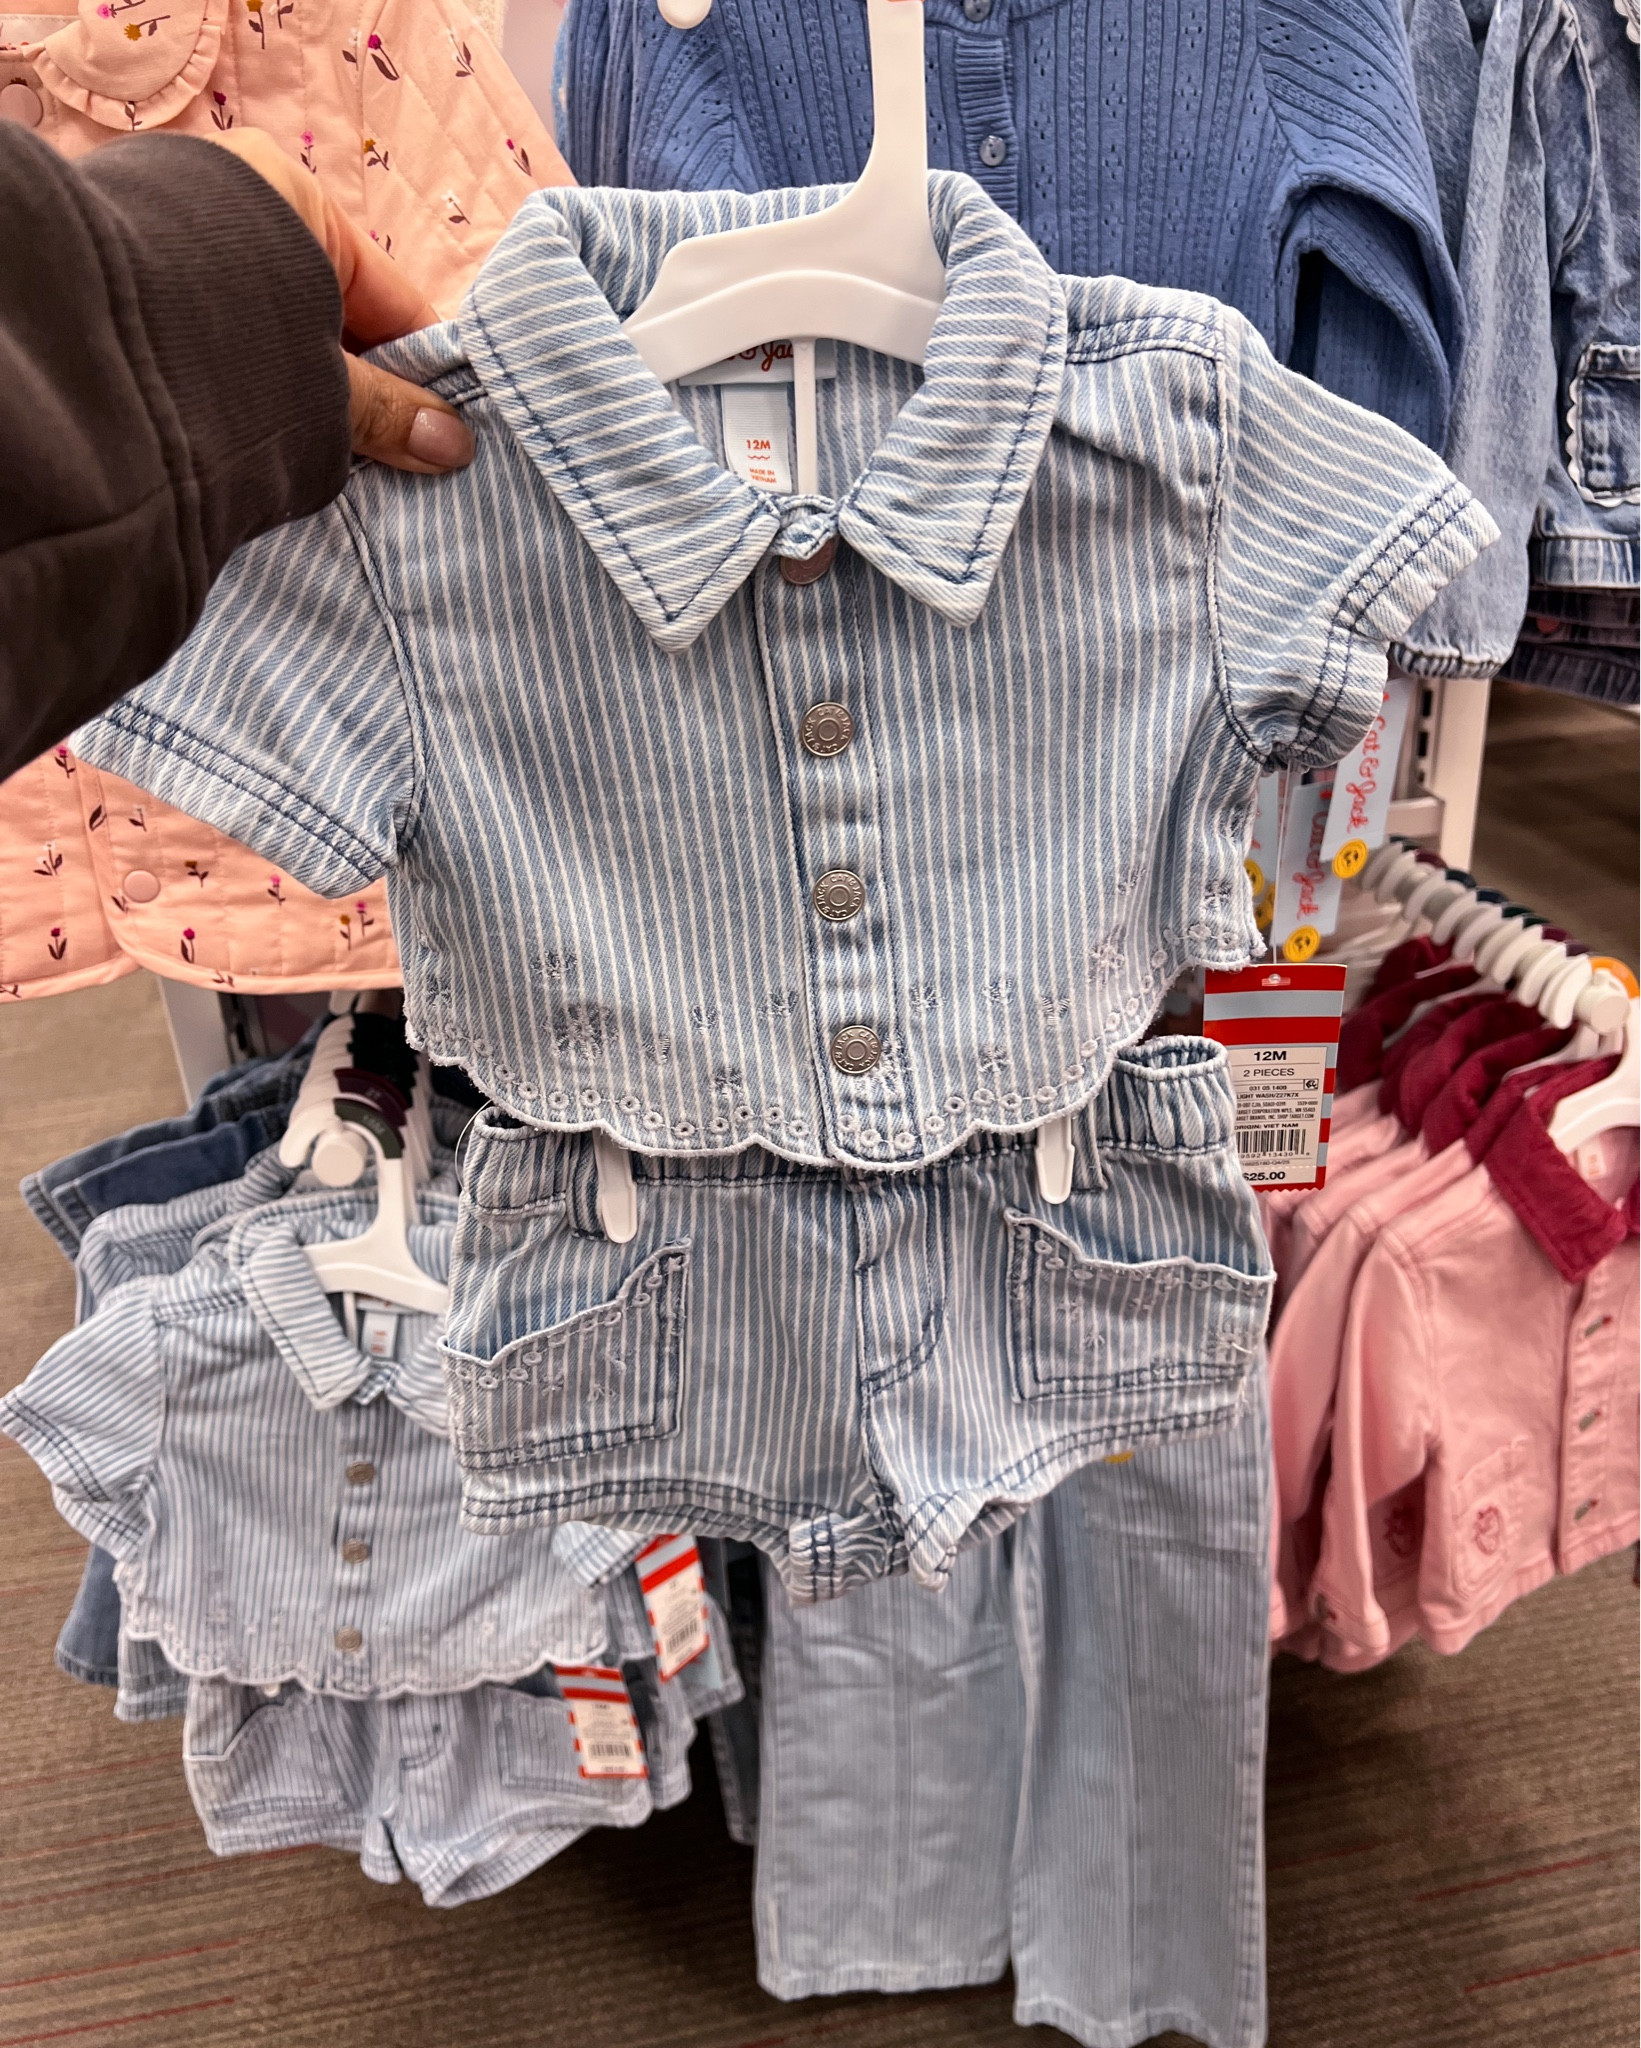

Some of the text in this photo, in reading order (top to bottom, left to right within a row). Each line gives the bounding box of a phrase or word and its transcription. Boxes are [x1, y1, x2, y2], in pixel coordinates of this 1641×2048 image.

[746, 439, 771, 450] 12M
[751, 475, 777, 483] VIETNAM
[1253, 1050, 1287, 1062] 12M
[1243, 1068, 1295, 1078] 2 PIECES
[1242, 1171, 1286, 1181] $25.00
